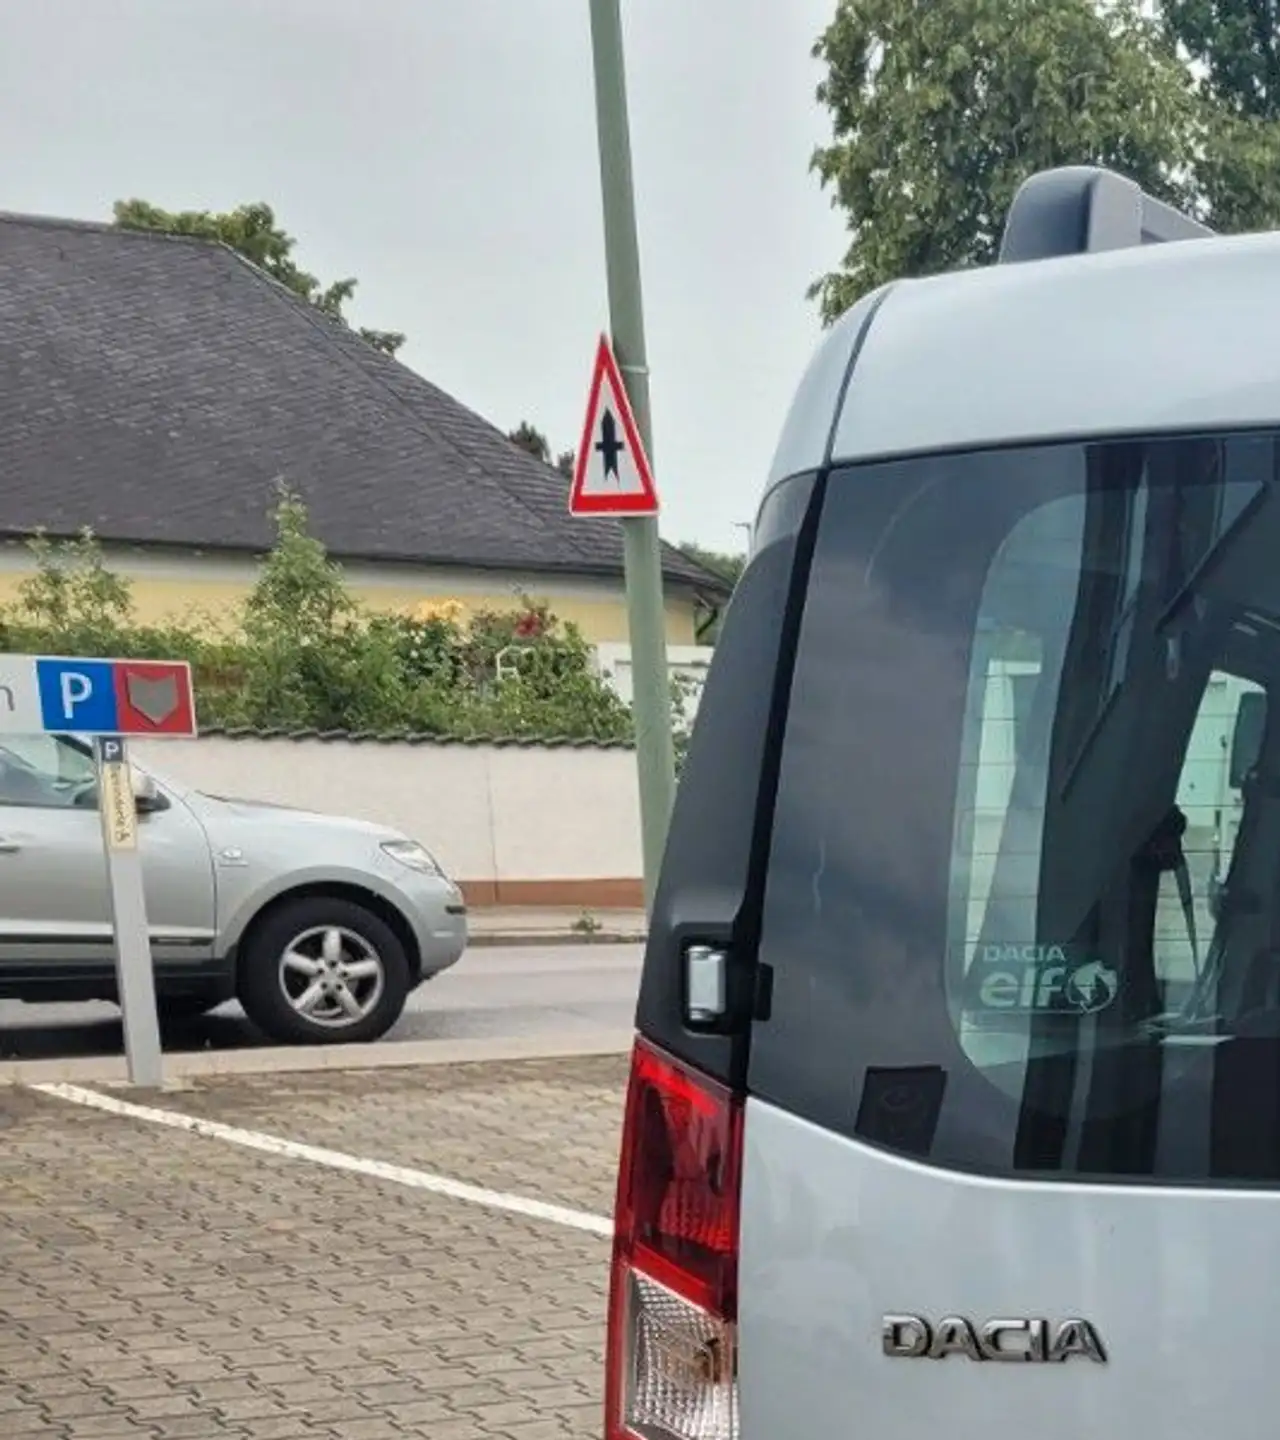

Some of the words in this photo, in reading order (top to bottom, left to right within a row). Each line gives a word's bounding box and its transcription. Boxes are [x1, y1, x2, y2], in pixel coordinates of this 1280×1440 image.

[60, 671, 93, 719] P
[104, 741, 120, 759] P
[983, 945, 1066, 962] DACIA
[980, 967, 1067, 1008] elf
[882, 1313, 1108, 1363] DACIA
